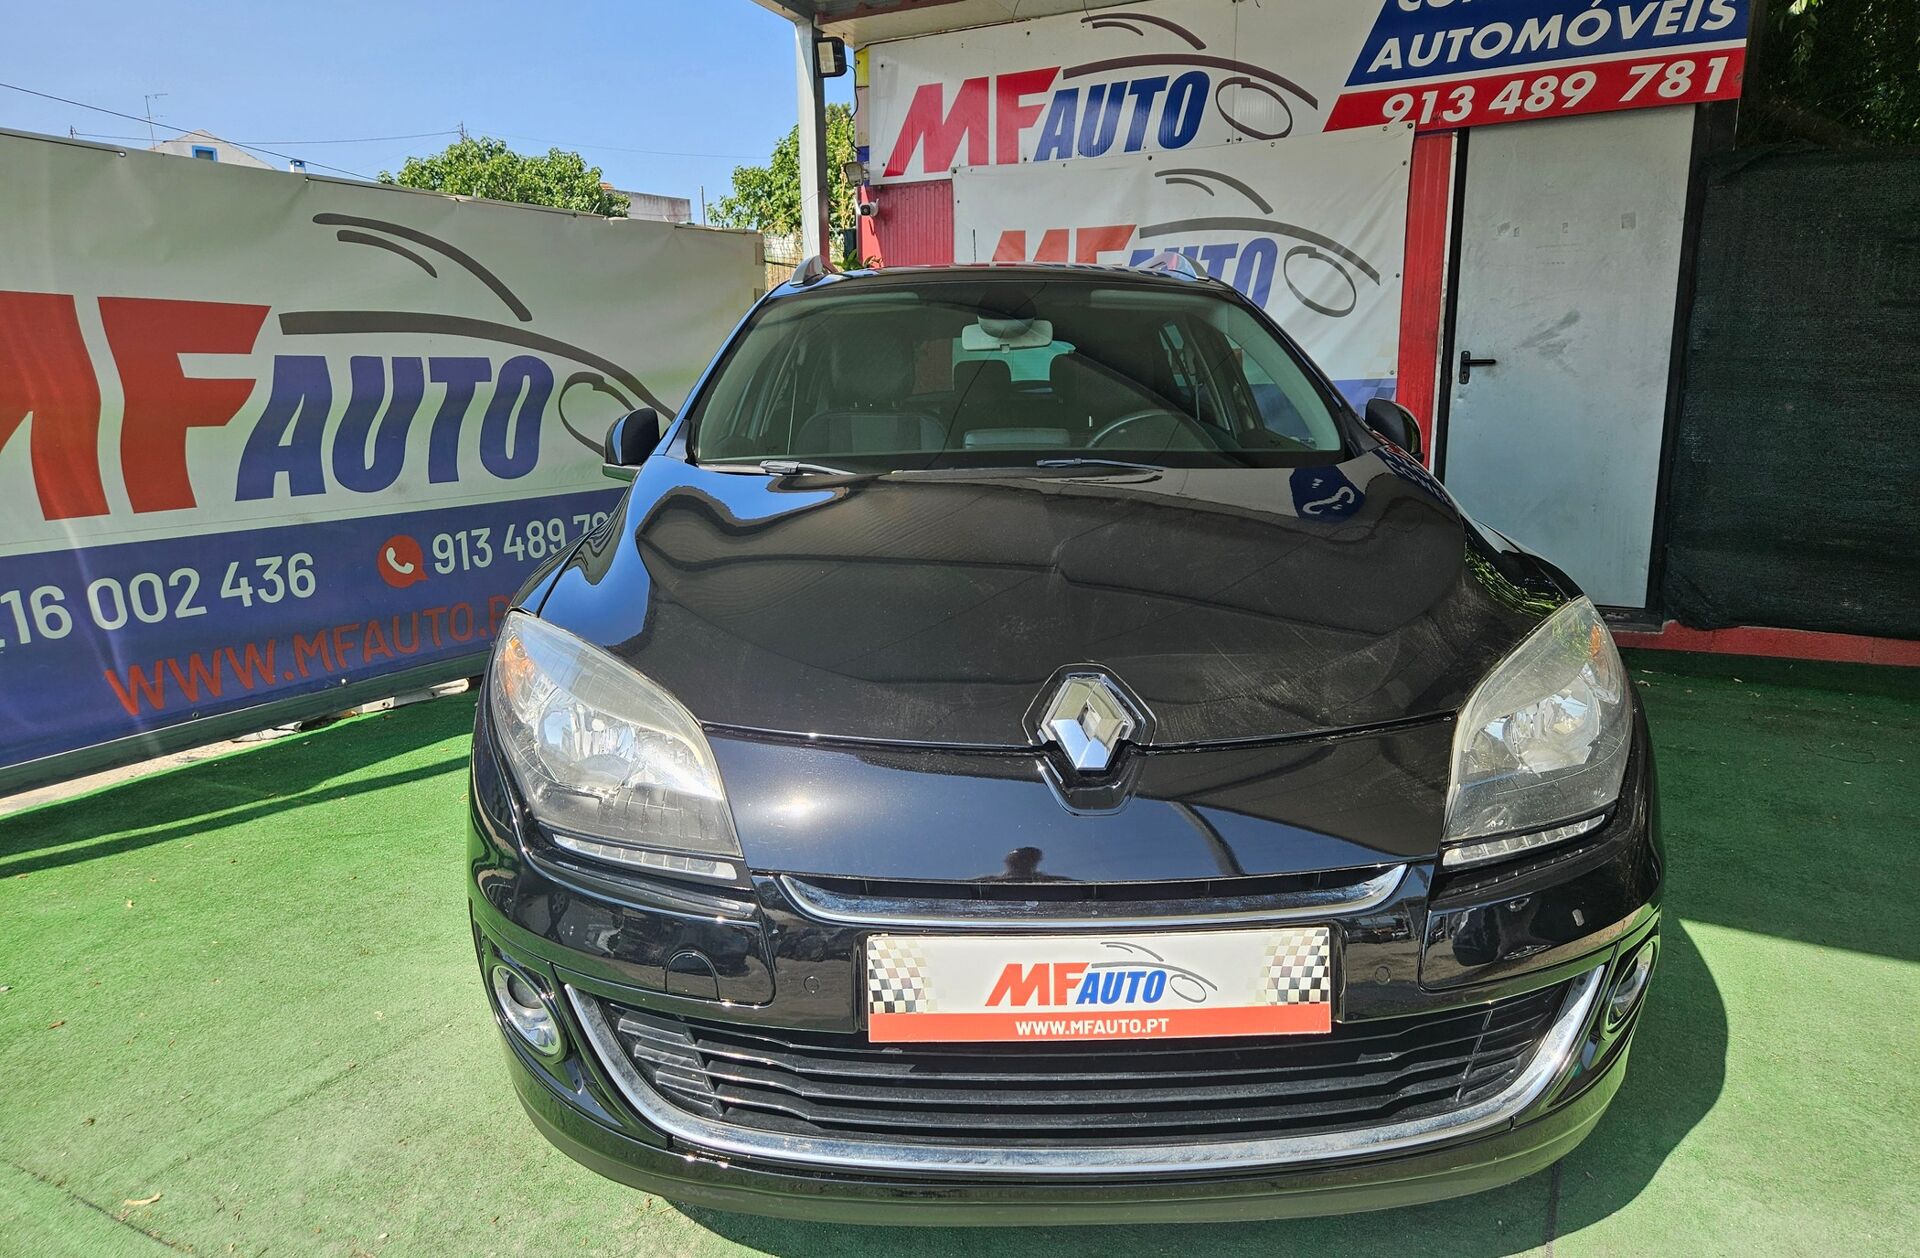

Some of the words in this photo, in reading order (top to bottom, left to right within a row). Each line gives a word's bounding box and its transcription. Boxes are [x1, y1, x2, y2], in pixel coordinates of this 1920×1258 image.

[1367, 0, 1737, 73] AUTOMÓVEIS
[1382, 86, 1476, 125] 913
[1489, 70, 1597, 115] 489
[1618, 56, 1730, 103] 781
[432, 527, 493, 575] 913
[503, 518, 567, 561] 489
[0, 585, 73, 648] 16
[87, 567, 208, 630] 002
[220, 552, 316, 607] 436
[104, 594, 516, 717] WWW.MFAUTO.P
[1015, 1018, 1169, 1036] WWW.MFAUTO.PT
